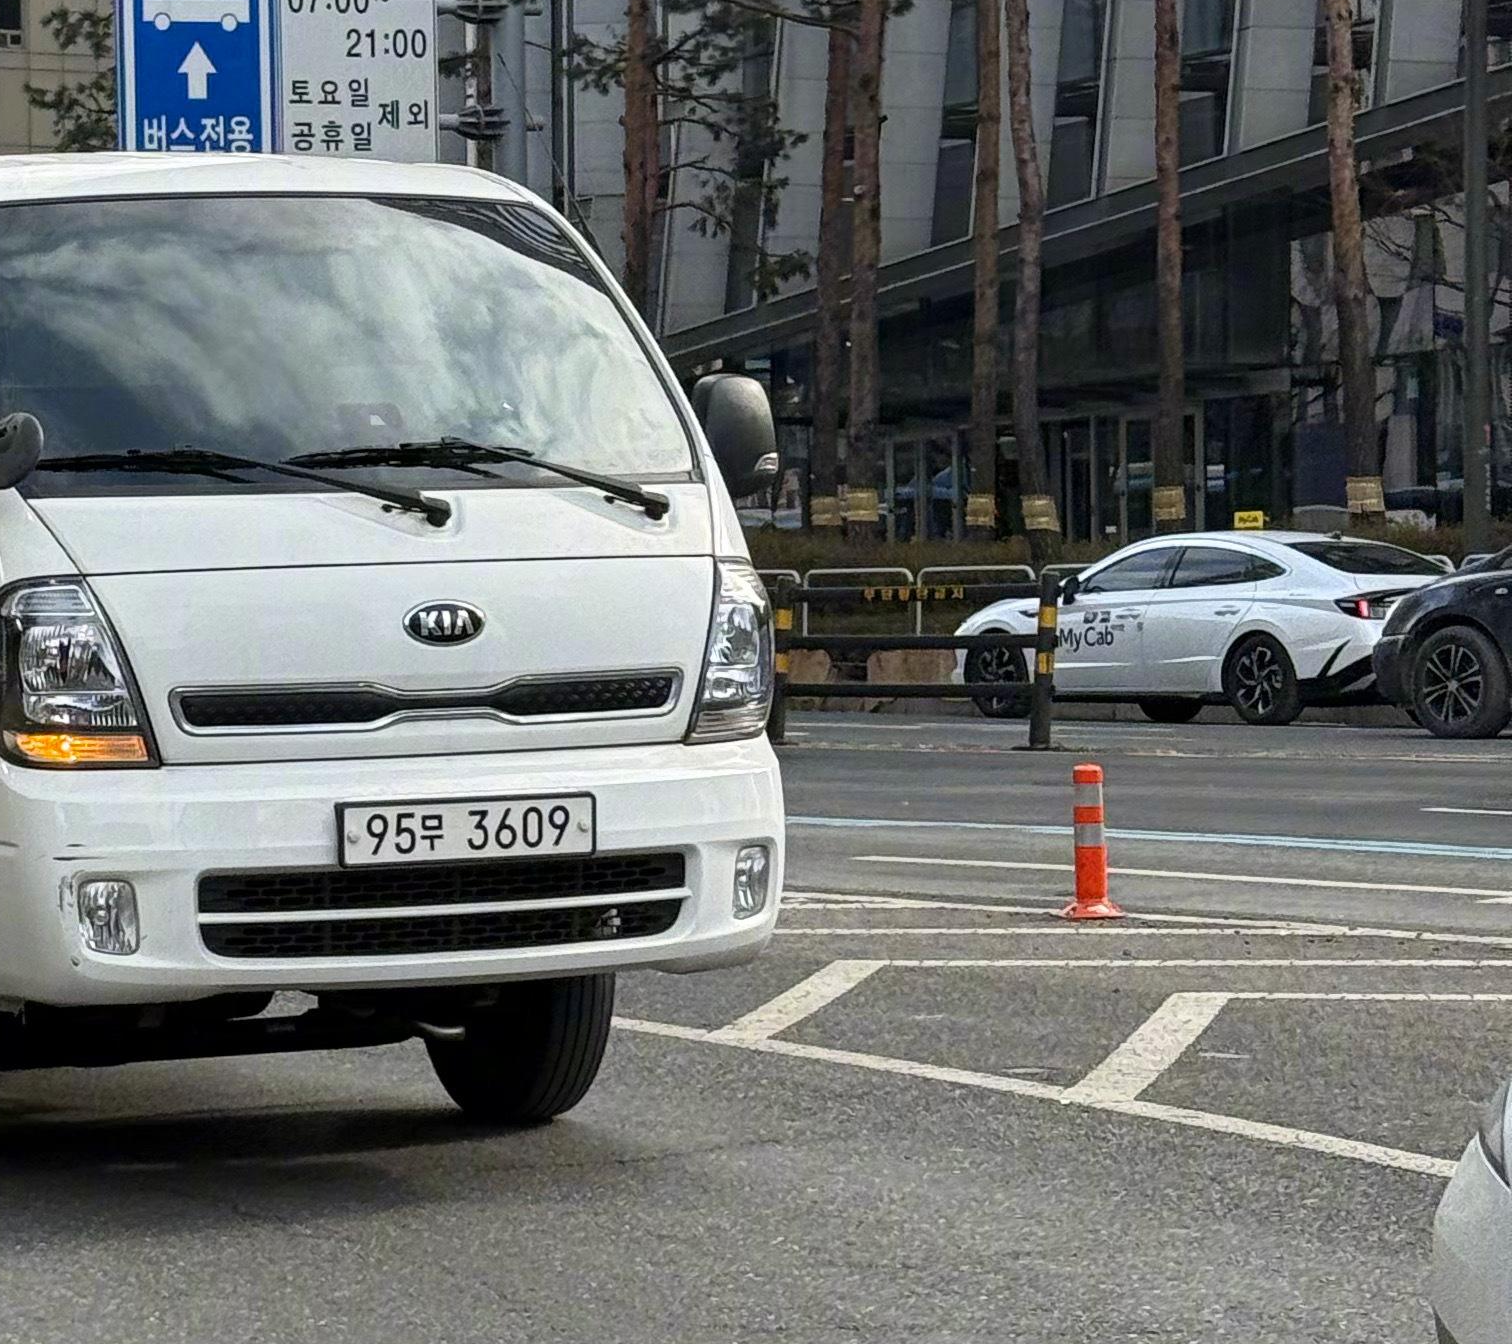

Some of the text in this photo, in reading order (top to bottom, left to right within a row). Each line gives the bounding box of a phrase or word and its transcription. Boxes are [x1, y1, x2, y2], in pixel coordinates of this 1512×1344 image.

[346, 29, 427, 59] 21:00
[288, 78, 369, 108] 토요일
[378, 100, 429, 130] 제외
[142, 115, 253, 152] 버스전용
[291, 122, 372, 151] 공휴일
[417, 609, 476, 637] KIA
[365, 805, 571, 856] 95무 3609
